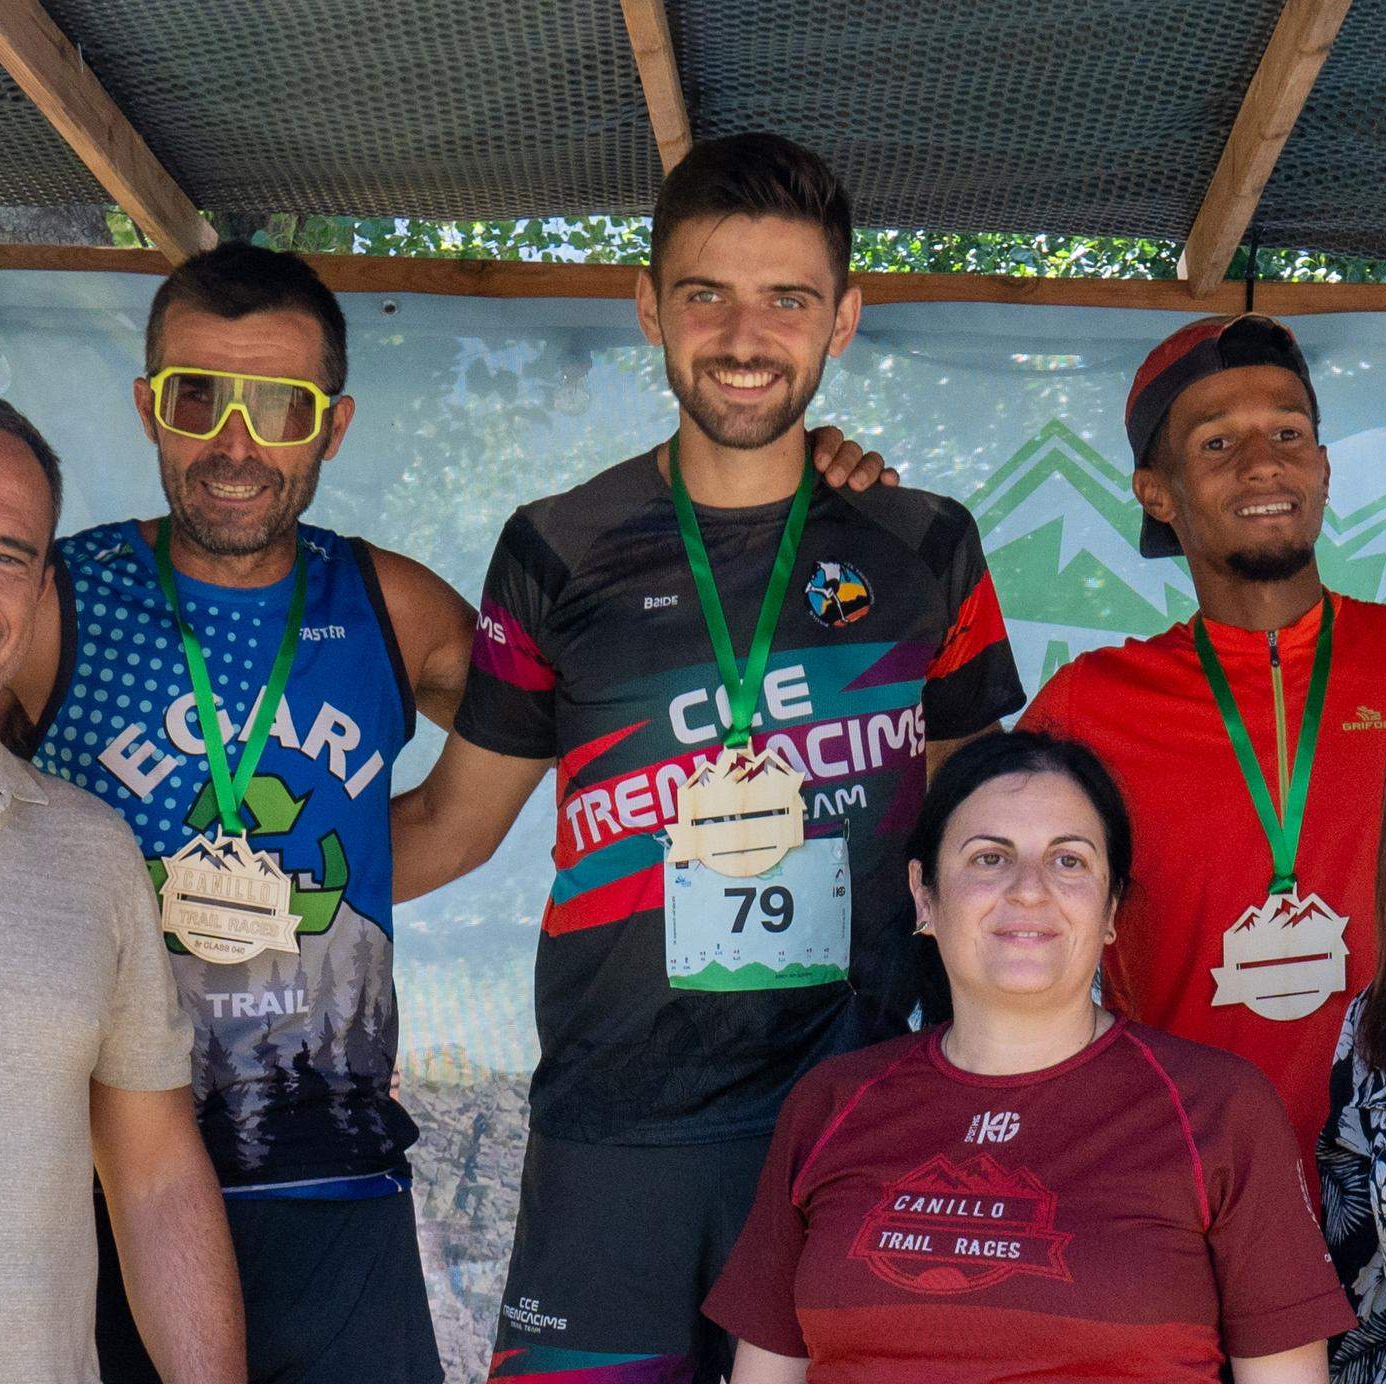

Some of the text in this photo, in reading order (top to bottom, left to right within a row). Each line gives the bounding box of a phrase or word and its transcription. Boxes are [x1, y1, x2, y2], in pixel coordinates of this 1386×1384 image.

[566, 703, 926, 852] TRENACIMS
[182, 871, 271, 901] CANILLO
[724, 885, 795, 934] 79
[206, 990, 310, 1019] TRAIL
[893, 1195, 1005, 1219] CANILLO
[878, 1231, 1021, 1259] TRAIL RACES
[519, 1296, 540, 1312] CCE
